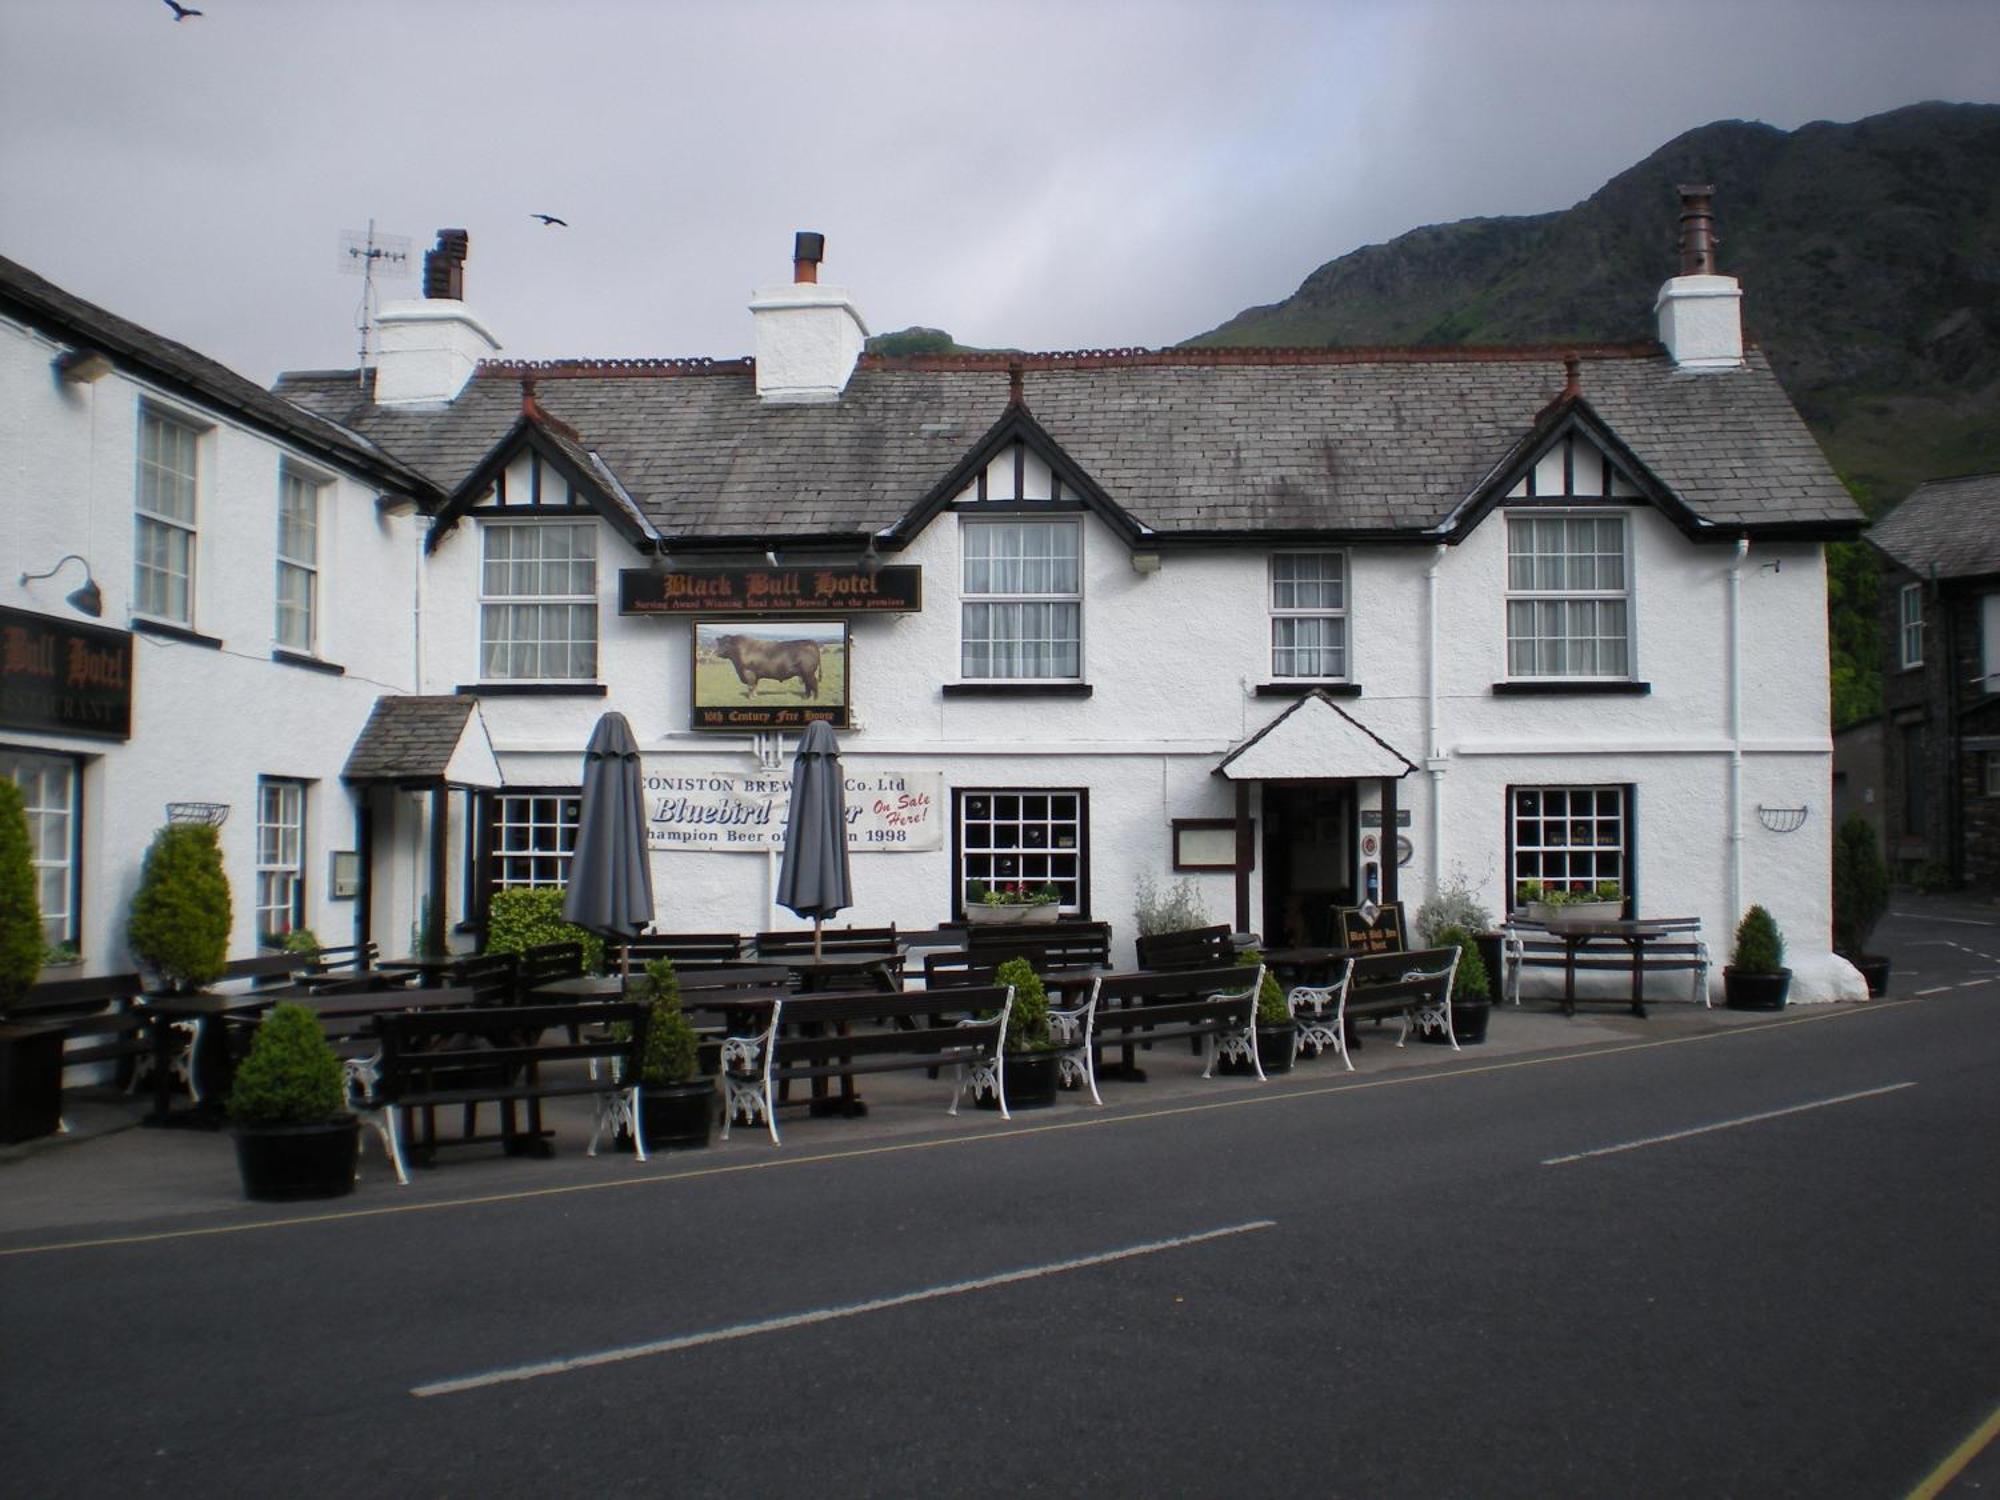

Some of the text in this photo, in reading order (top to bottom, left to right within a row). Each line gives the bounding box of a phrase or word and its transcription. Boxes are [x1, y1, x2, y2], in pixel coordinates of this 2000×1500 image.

[663, 570, 879, 598] Black Bull Hotel
[634, 600, 669, 610] Serving
[671, 600, 700, 609] Award
[705, 599, 742, 609] Winning
[848, 598, 864, 608] the
[3, 626, 124, 688] Bull Hotel
[728, 710, 771, 724] Century
[775, 710, 799, 723] Free
[844, 778, 871, 791] Co.
[877, 777, 905, 791] Ltd
[650, 797, 773, 825] Bluebird
[872, 792, 932, 814] On Sale
[885, 806, 928, 827] Here!
[645, 827, 718, 845] hampion
[726, 829, 764, 842] Beer
[865, 828, 906, 843] 1998
